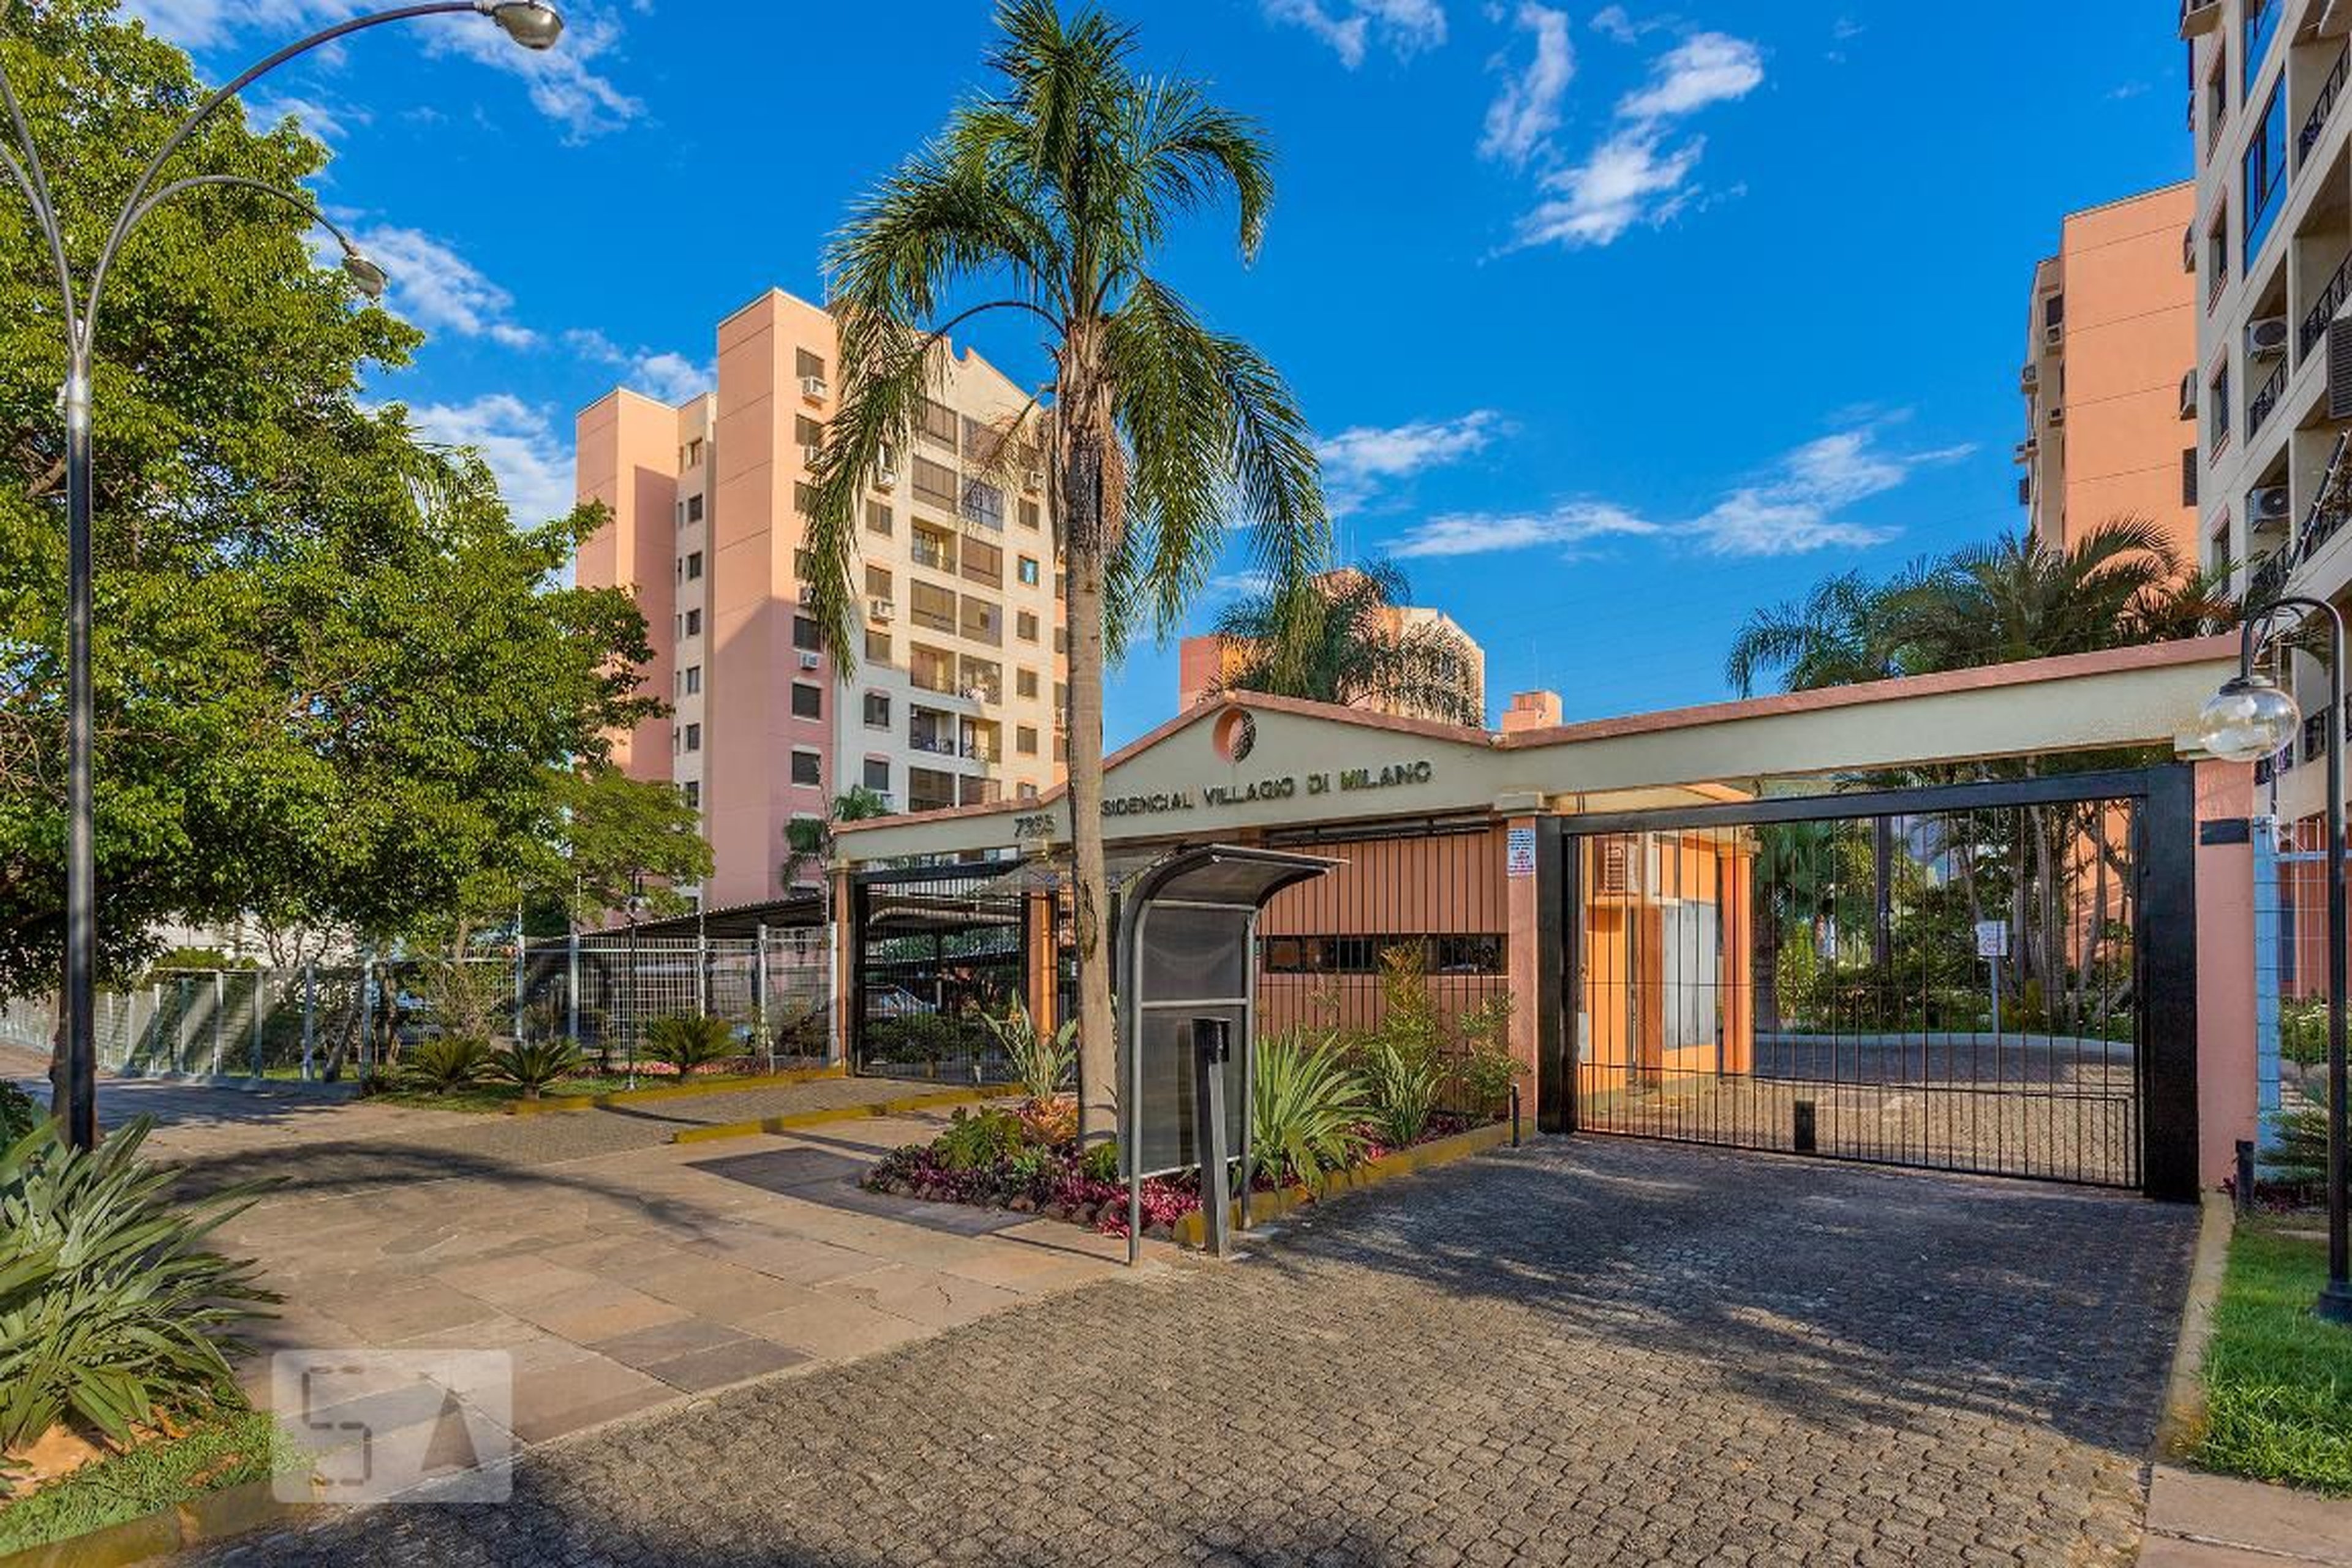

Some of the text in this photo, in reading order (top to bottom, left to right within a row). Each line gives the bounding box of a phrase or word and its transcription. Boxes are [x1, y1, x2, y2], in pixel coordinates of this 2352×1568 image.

[1101, 793, 1194, 817] SIDENCIAL
[1203, 777, 1295, 807] VILLAGIO
[1307, 773, 1331, 795] DI
[1340, 761, 1431, 791] MILANO
